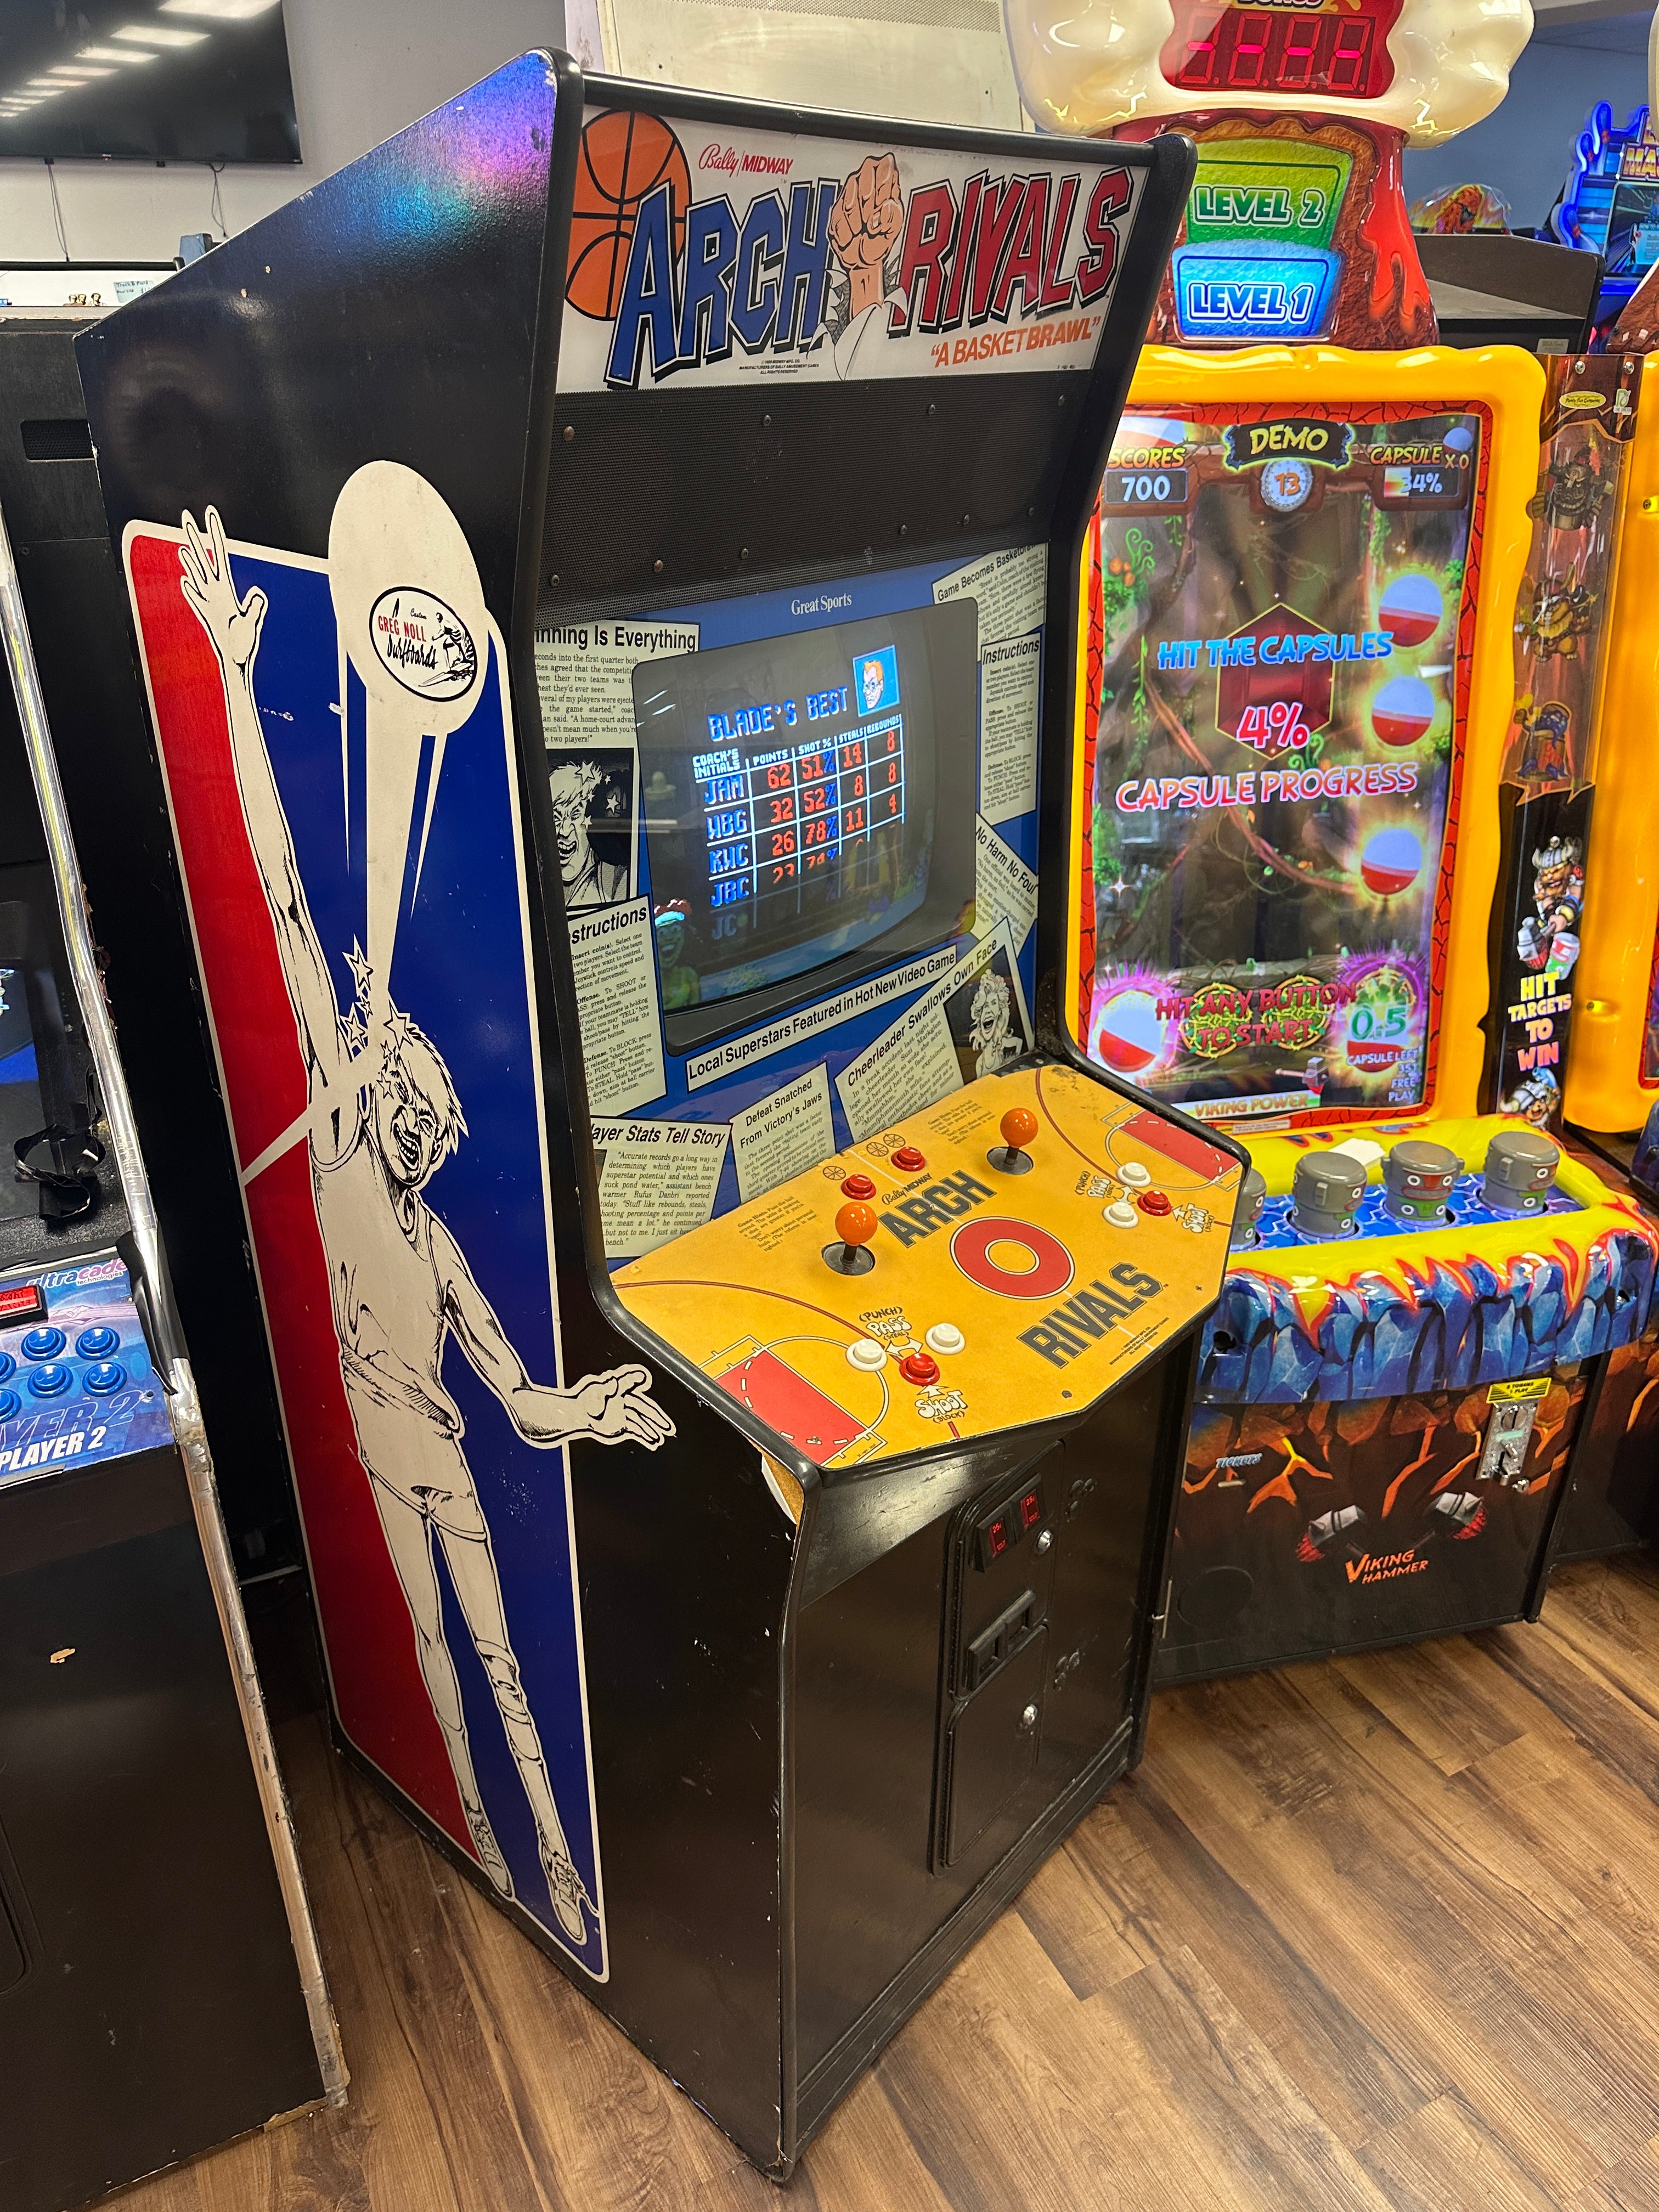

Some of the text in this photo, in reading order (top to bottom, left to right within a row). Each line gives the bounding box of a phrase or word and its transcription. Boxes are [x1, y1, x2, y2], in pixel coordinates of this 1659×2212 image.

[698, 143, 794, 178] Bally MIDWAY
[1192, 185, 1325, 228] LEVEL 2
[604, 166, 1135, 389] ARCH RIVALS
[1187, 281, 1315, 324] LEVEL 1
[1249, 426, 1329, 455] DEMO
[1109, 447, 1186, 468] SCORES
[1370, 445, 1442, 466] CAPSULE
[1121, 475, 1171, 502] 700
[1275, 472, 1300, 495] 13
[1400, 472, 1443, 494] 34%
[938, 583, 960, 602] Game
[961, 562, 995, 589] Becomes
[410, 608, 427, 619] Custom
[791, 593, 852, 616] Great Sports
[378, 615, 427, 642] GREG NOLL
[595, 625, 608, 646] Is
[615, 627, 696, 653] Everything
[387, 634, 438, 670] Surfboards
[573, 653, 584, 662] the
[585, 654, 599, 663] first
[601, 656, 624, 665] quarter
[626, 656, 639, 664] both
[983, 637, 1040, 665] Instructions
[1158, 631, 1394, 670] HIT THE CAPSULES
[551, 663, 601, 674] agreed that the
[554, 674, 571, 682] their
[574, 675, 586, 683] two
[708, 686, 848, 742] BLADE'S BEST
[867, 717, 899, 734] REBOUNDS
[1237, 702, 1310, 749] 4%
[798, 738, 832, 755] SHOT %
[839, 729, 864, 743] STEALS
[887, 730, 896, 752] 8
[692, 748, 739, 768] COACH'S
[753, 749, 788, 766] POINTS
[801, 750, 835, 780] 51%
[843, 742, 862, 768] 14
[695, 759, 741, 778] INITIALS
[768, 763, 791, 789] 62
[888, 763, 896, 783] 8
[704, 774, 744, 804] JAM
[803, 783, 837, 812] 52%
[854, 775, 864, 796] 8
[1116, 763, 1418, 813] CAPSULE PROGRESS
[770, 797, 794, 823] 32
[889, 793, 897, 814] 4
[806, 815, 838, 845] 78%
[845, 807, 864, 832] 11
[772, 830, 795, 856] 26
[976, 826, 1038, 895] No Harm No Foul
[711, 877, 750, 907] JBC
[571, 907, 647, 944] structions
[1520, 971, 1560, 1002] HIT
[848, 938, 997, 1086] Cheerleader Swallows Own Face
[1156, 983, 1357, 1021] HIT ANY BUTTON
[1508, 994, 1572, 1023] TARGETS
[689, 952, 955, 1080] Local Superstars Featured in Hot New Video Game
[1352, 1006, 1407, 1041] 0.5
[1199, 1019, 1313, 1049] TO START
[1525, 1018, 1554, 1043] TO
[1346, 1048, 1418, 1066] CAPSULE LEFT
[1517, 1041, 1560, 1072] WIN
[1389, 1089, 1415, 1102] PLAY
[1392, 1077, 1417, 1088] FREE
[746, 1078, 812, 1126] Defeat Snatched
[1195, 1093, 1309, 1117] VIKING POWER
[740, 1093, 822, 1149] From Victory's Jaws
[626, 1125, 662, 1142] Stats
[665, 1127, 690, 1143] Tell
[691, 1128, 726, 1148] Story
[609, 1161, 647, 1170] determining
[653, 1163, 670, 1171] which
[676, 1164, 697, 1172] players
[686, 1154, 698, 1163] long
[882, 1172, 933, 1205] Bally MIDWAY
[1087, 1175, 1111, 1199] PASS
[878, 1169, 998, 1249] ARCH
[1182, 1203, 1209, 1233] SHOOT
[77, 1271, 123, 1285] technologies
[859, 1306, 903, 1322] (PUNCH)
[866, 1316, 912, 1337] PASS
[1017, 1262, 1164, 1369] RIVALS
[883, 1331, 910, 1341] (STEAL)
[103, 1390, 144, 1427] 2
[915, 1390, 968, 1419] SHOOT
[933, 1410, 965, 1424] (BLOCK)
[0, 1431, 85, 1471] PLAYER
[87, 1426, 107, 1450] 2
[1215, 1453, 1263, 1469] TICKETS
[1345, 1549, 1415, 1584] VIKING
[1361, 1560, 1429, 1584] HAMMER
